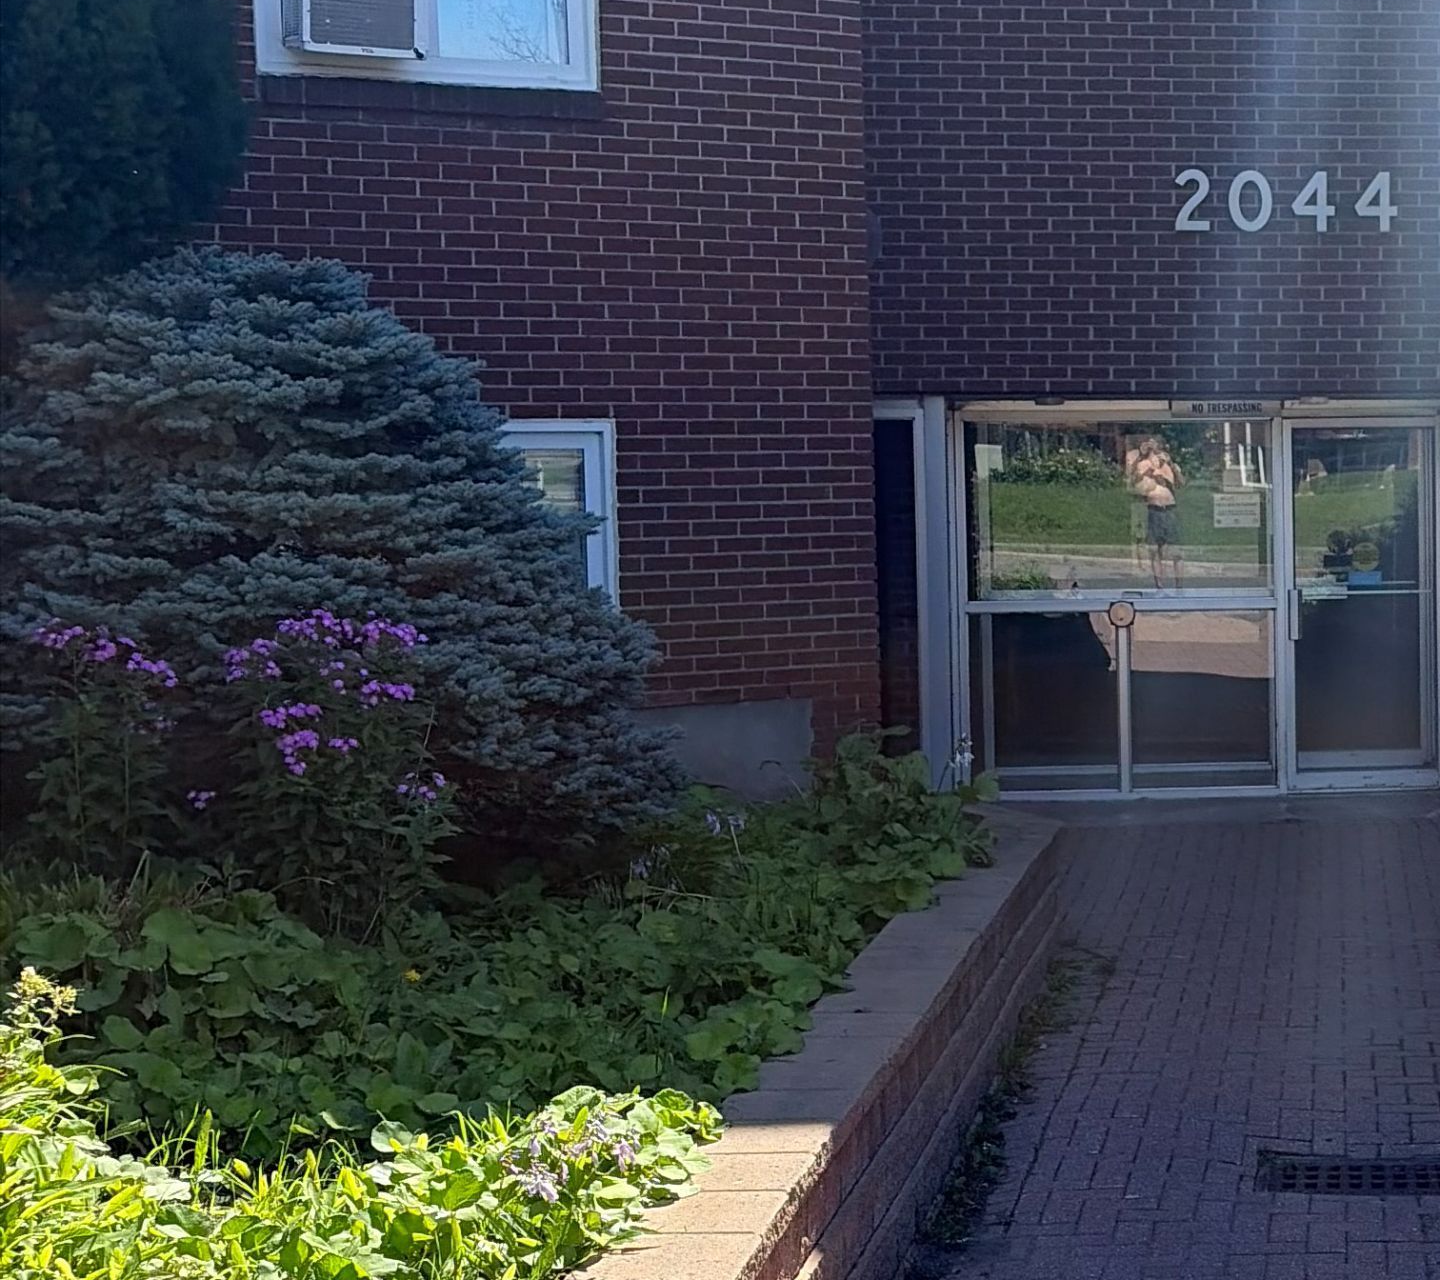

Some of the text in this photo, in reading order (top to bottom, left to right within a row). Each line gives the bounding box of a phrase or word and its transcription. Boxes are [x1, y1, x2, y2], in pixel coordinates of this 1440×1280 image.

[1174, 168, 1398, 233] 2044
[1192, 402, 1263, 414] NO TRESPASSING
